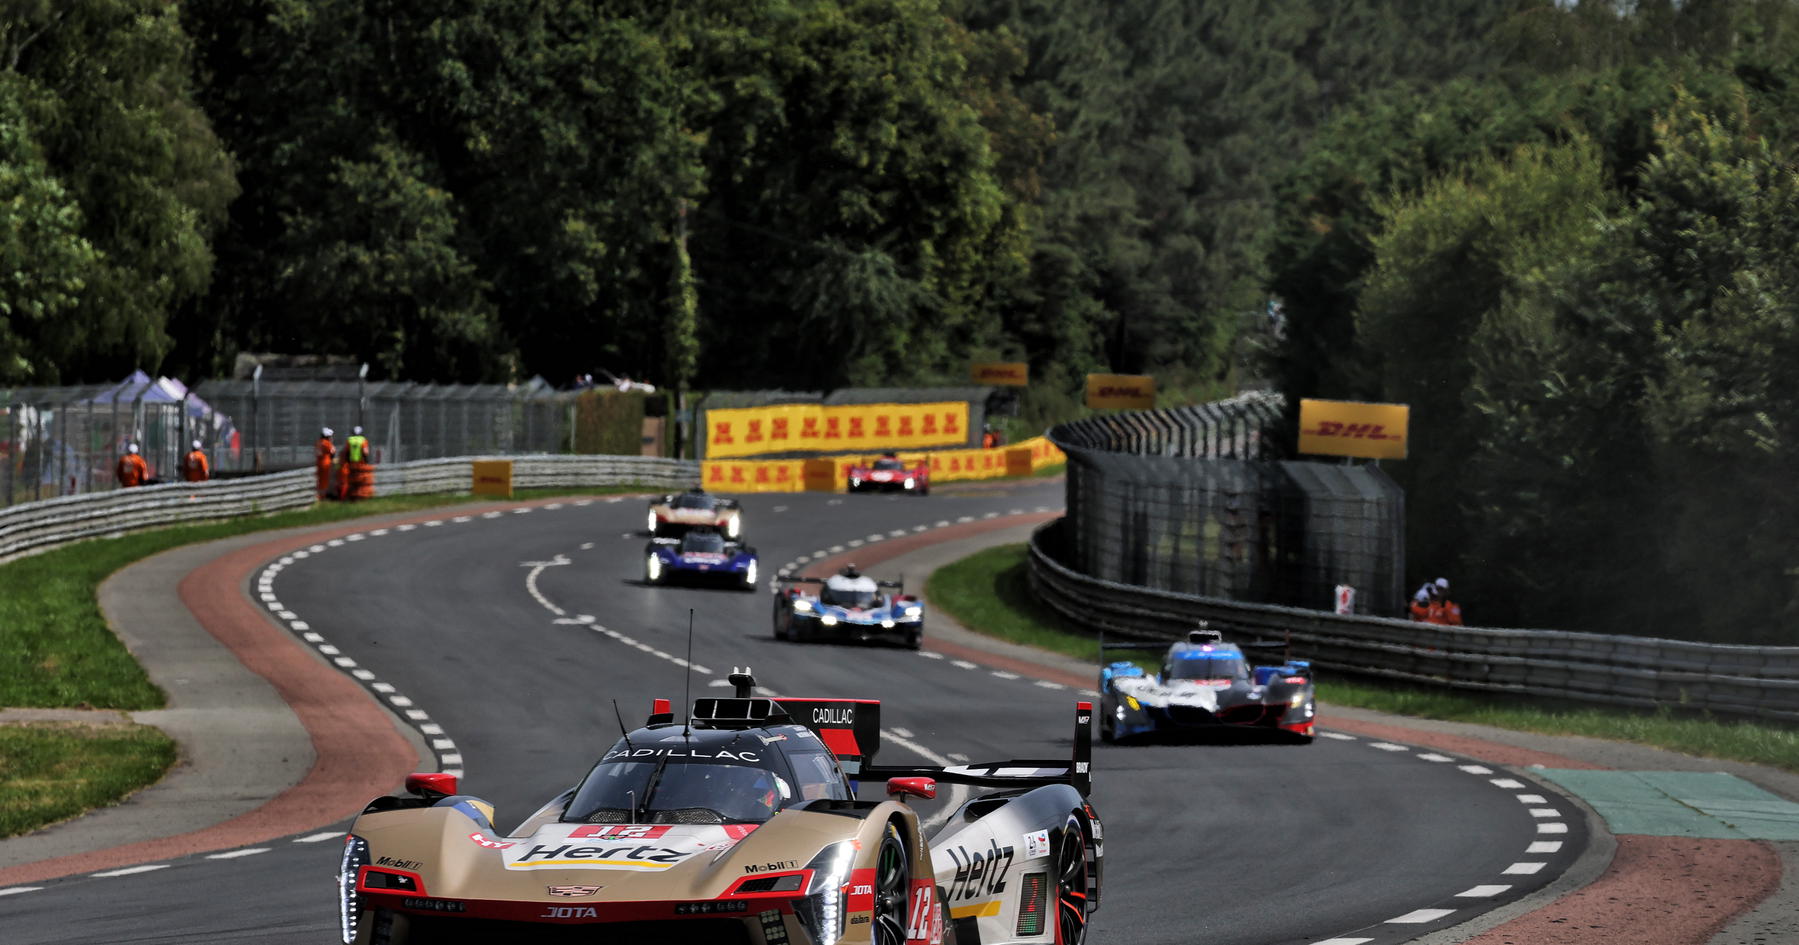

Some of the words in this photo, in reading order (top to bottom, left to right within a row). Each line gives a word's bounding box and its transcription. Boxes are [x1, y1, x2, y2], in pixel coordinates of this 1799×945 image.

[1317, 421, 1388, 440] DHL
[812, 707, 853, 724] CADILLAC
[602, 748, 760, 763] CADILLAC
[517, 844, 692, 863] Hertz
[376, 856, 411, 868] Mobil
[744, 861, 785, 873] Mobil
[946, 838, 1014, 902] Hertz
[850, 884, 872, 896] JOTA
[540, 906, 598, 918] JOTA
[907, 886, 931, 940] 12
